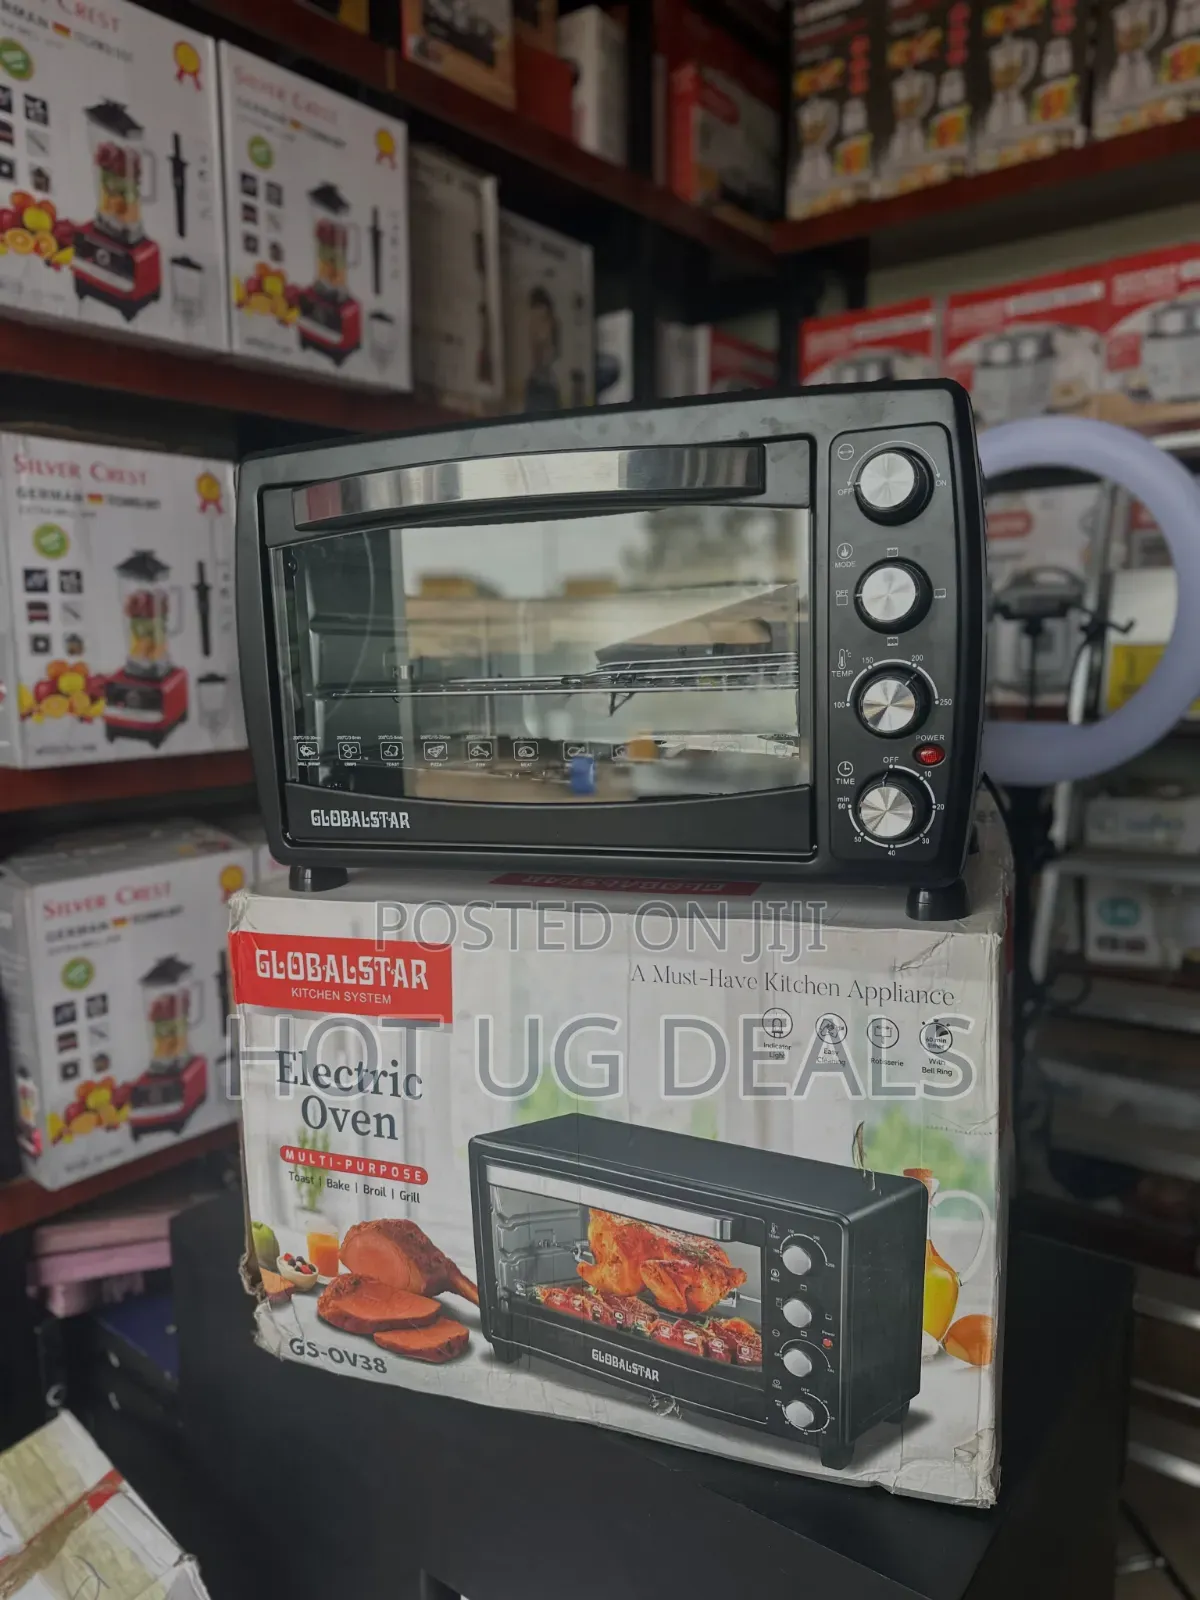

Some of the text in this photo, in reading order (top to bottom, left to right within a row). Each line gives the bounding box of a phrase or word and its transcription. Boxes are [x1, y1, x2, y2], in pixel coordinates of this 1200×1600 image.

[837, 488, 853, 496] OFF
[862, 656, 874, 664] 150
[911, 654, 924, 662] 200
[831, 670, 854, 678] TEMP
[834, 701, 846, 709] 100
[939, 698, 952, 706] 250
[883, 756, 899, 764] OFF
[924, 770, 932, 778] 10
[936, 803, 945, 811] 20
[310, 809, 410, 828] GLOBALSTAR
[887, 849, 896, 857] 40
[255, 949, 429, 990] GLOBALSTAR
[631, 964, 955, 1007] A Must-Have Kitchen Appliance
[291, 987, 392, 1005] KITCHEN SYSTEM
[763, 1042, 792, 1050] Indicator
[769, 1052, 785, 1060] Light
[275, 1050, 423, 1100] Electric
[937, 1068, 953, 1077] Ring
[301, 1095, 399, 1141] Oven
[285, 1149, 423, 1182] MULTI-PURPOSE
[289, 1170, 421, 1204] Toast Bake Broil Grill
[288, 1336, 388, 1374] GS-OV38
[591, 1348, 660, 1383] GLOBALSTAR
